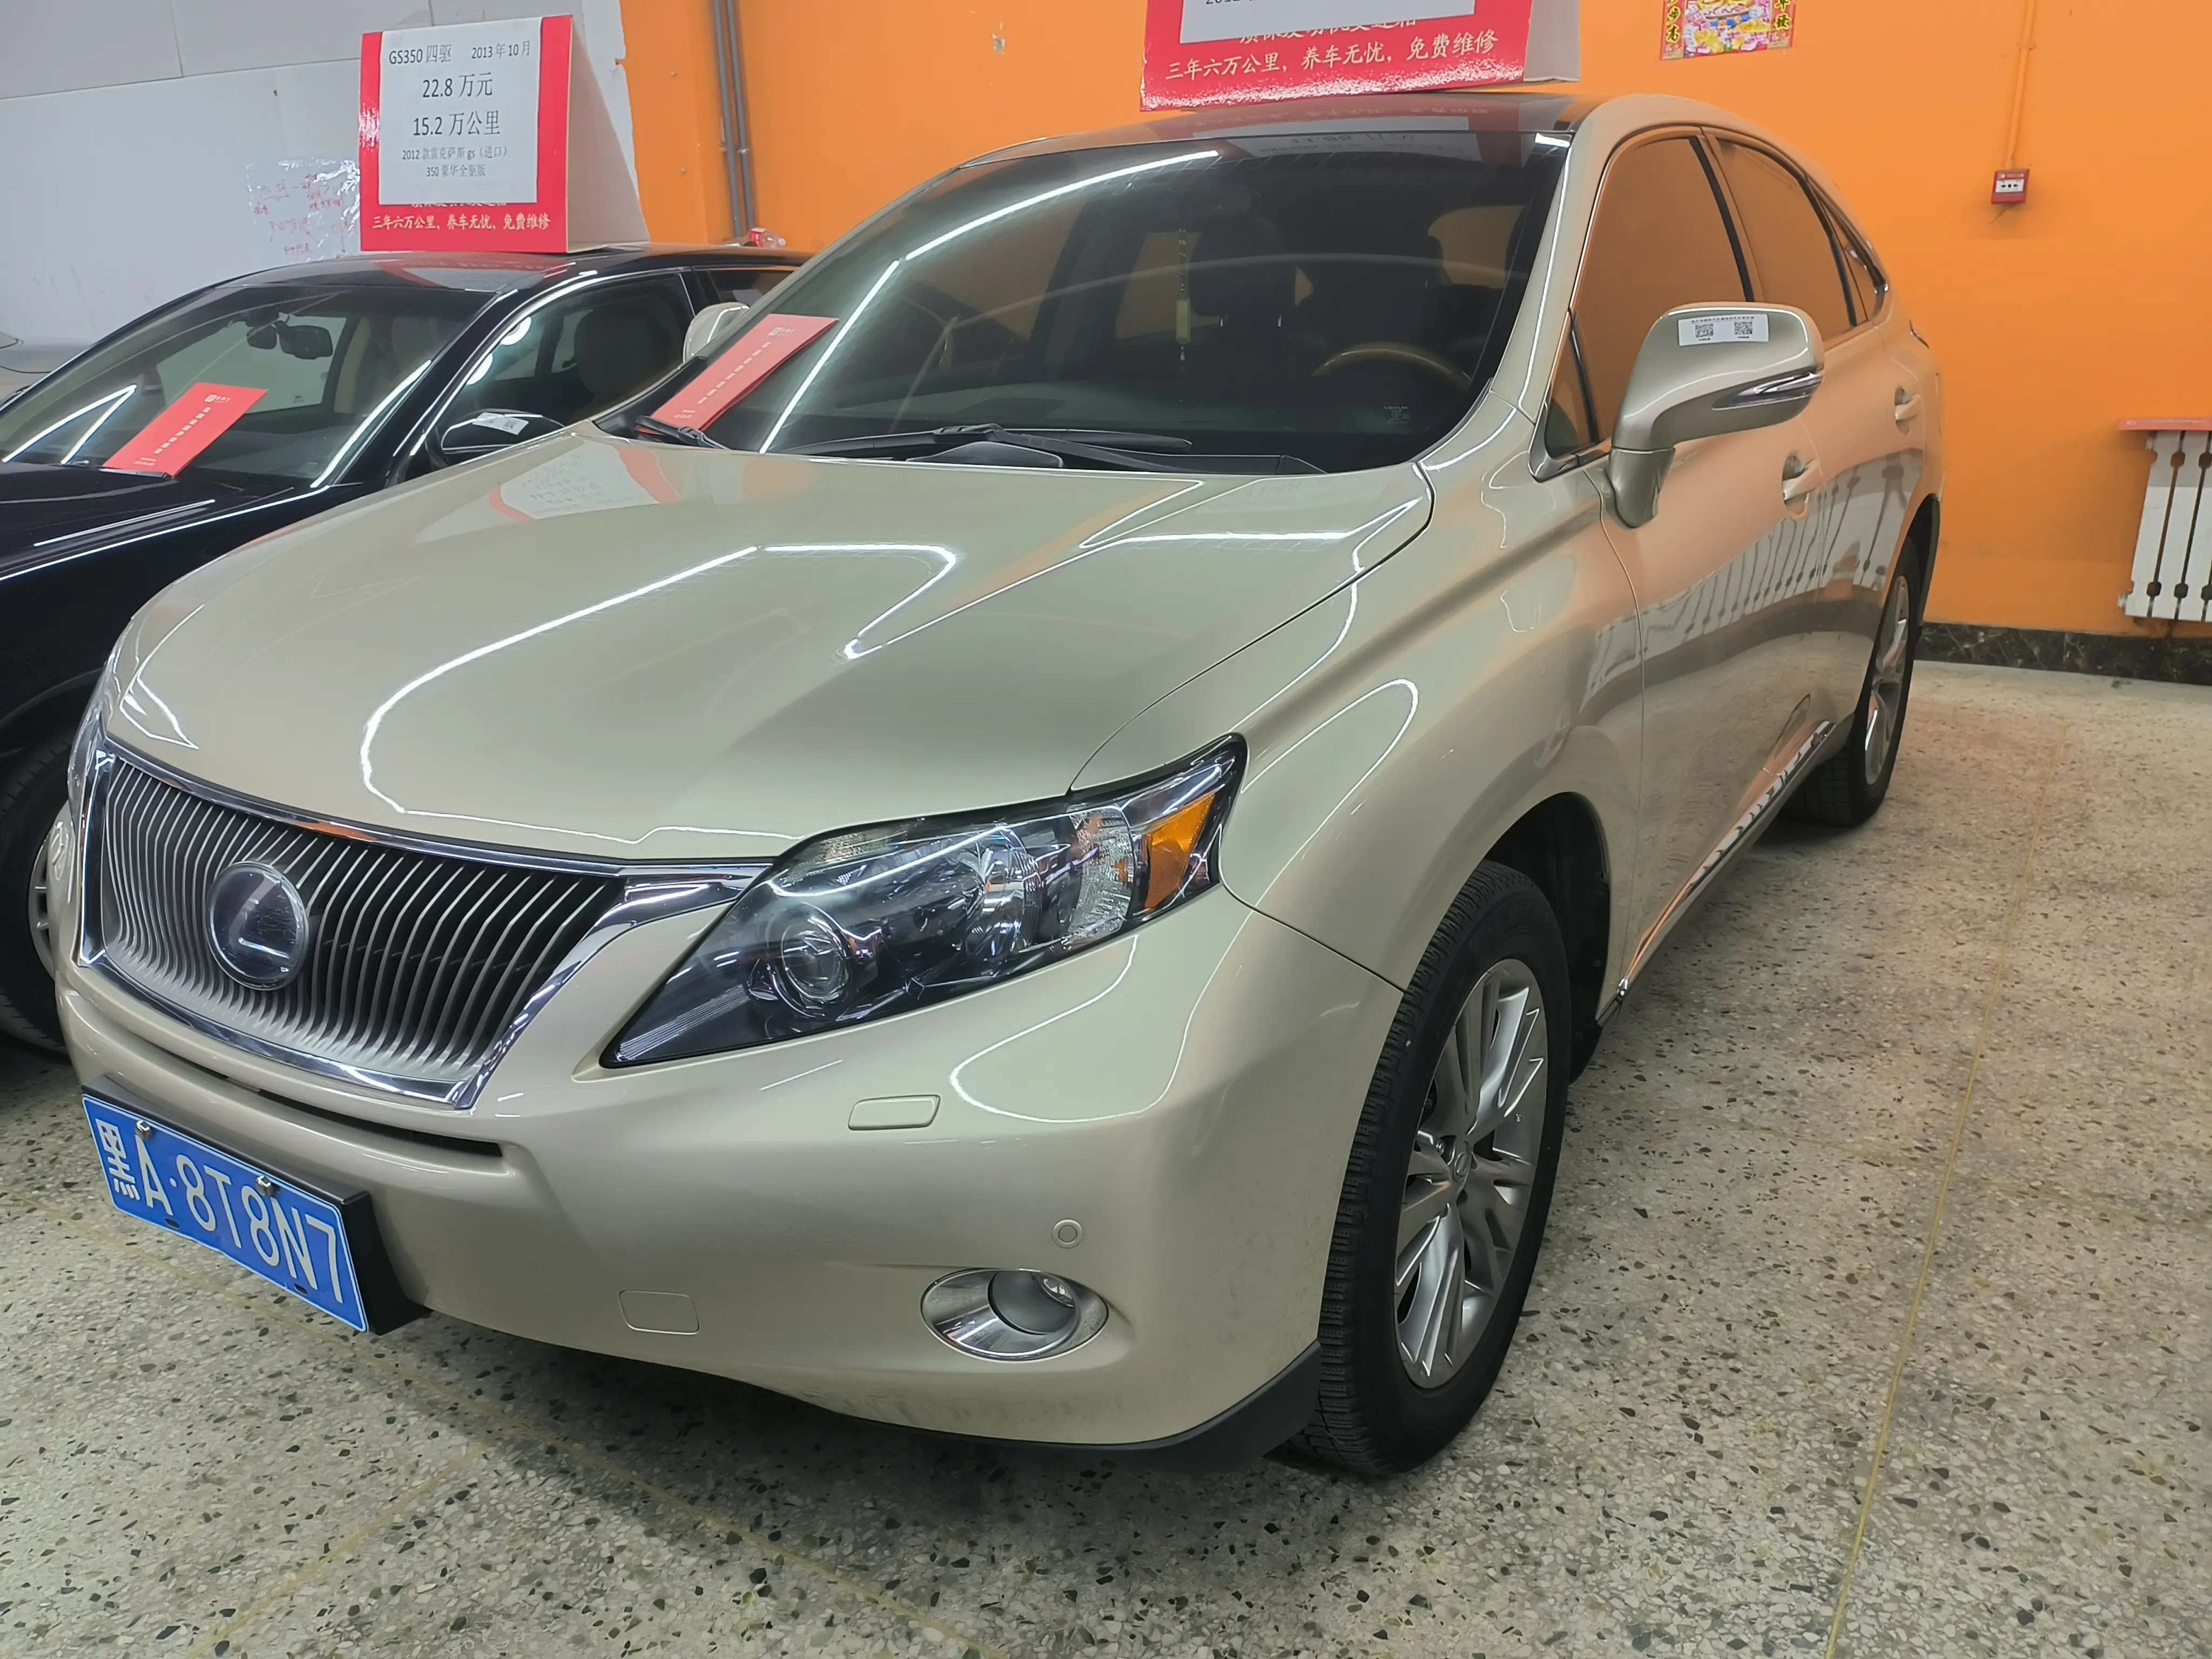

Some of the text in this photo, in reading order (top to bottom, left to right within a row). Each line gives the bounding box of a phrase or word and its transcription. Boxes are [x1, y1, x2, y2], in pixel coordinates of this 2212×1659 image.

[389, 49, 423, 64] GS350
[426, 44, 452, 63] 四驱
[422, 72, 493, 98] 22.8 万元
[413, 110, 500, 137] 15.2 万公里
